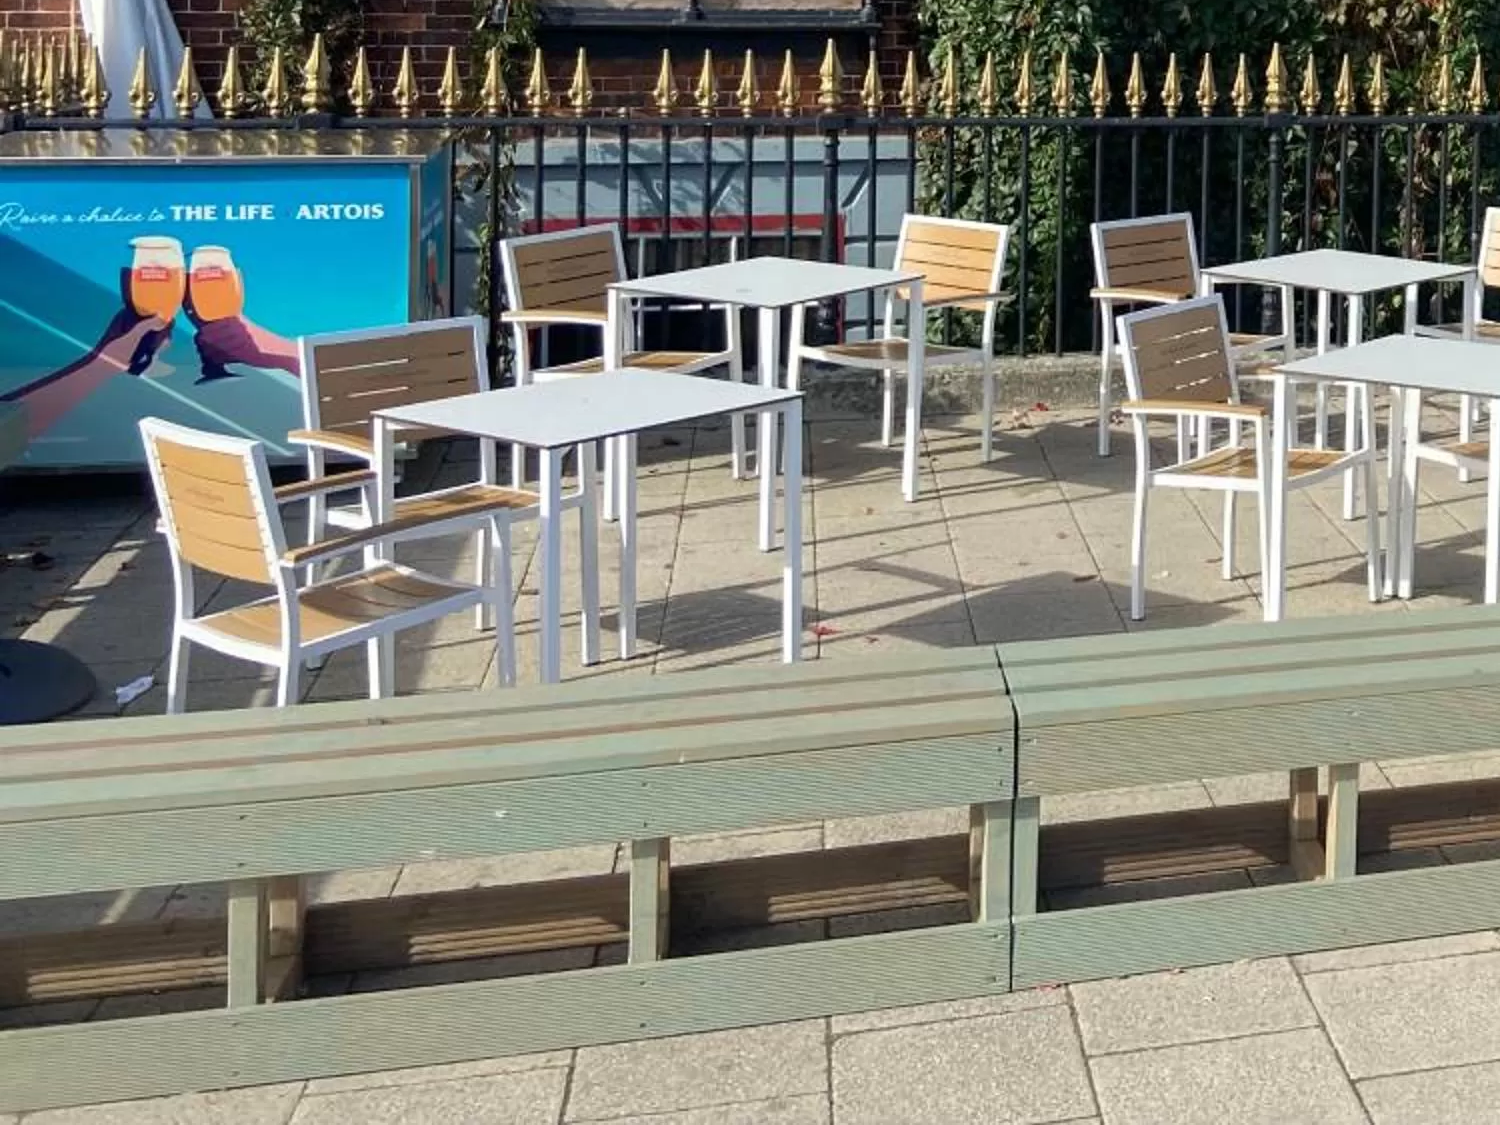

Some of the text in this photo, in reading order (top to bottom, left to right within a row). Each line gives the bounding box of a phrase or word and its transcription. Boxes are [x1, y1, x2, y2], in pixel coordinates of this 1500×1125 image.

[0, 202, 58, 231] Raise
[79, 206, 143, 223] chalice
[148, 207, 166, 222] to
[171, 204, 217, 221] THE
[225, 204, 275, 221] LIFE
[295, 203, 385, 220] ARTOIS
